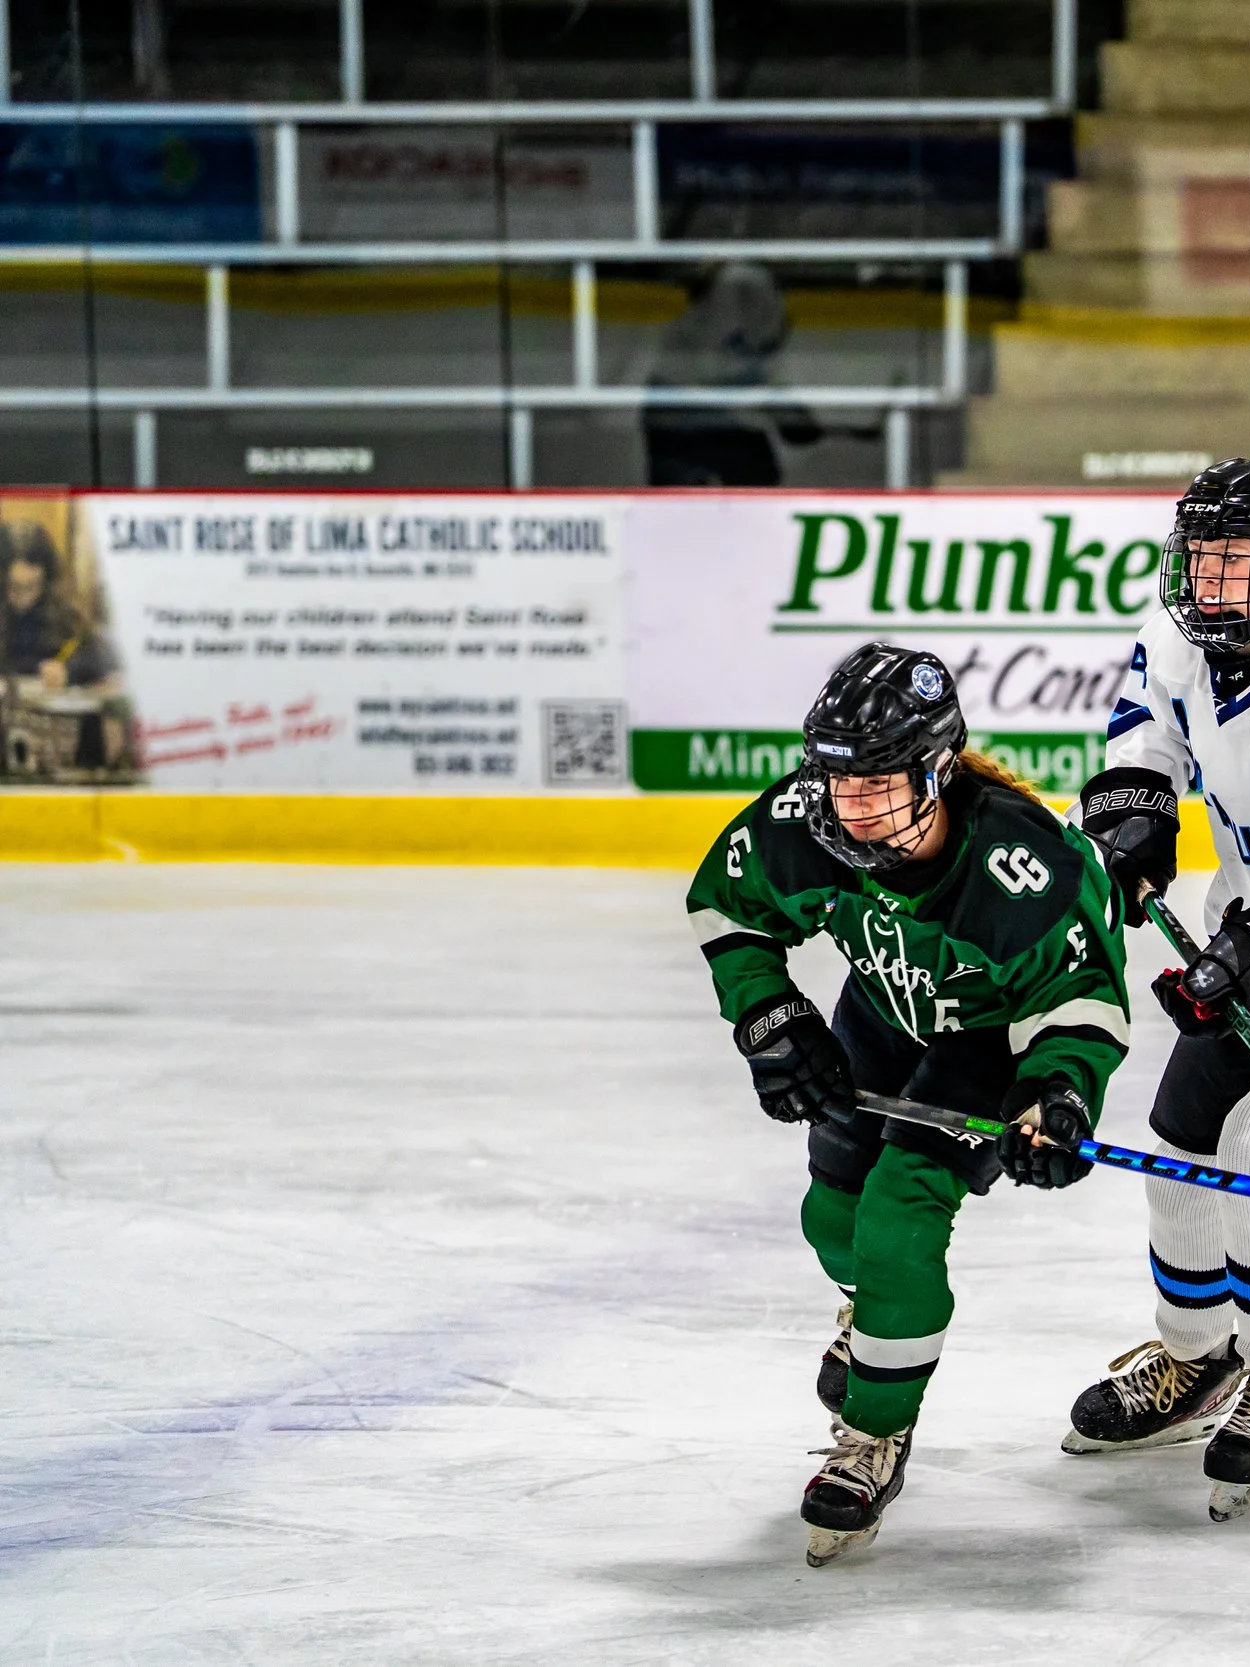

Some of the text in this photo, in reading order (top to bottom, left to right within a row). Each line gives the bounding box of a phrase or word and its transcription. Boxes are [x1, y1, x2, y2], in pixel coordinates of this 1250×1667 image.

[1184, 503, 1222, 513] CCM
[107, 515, 608, 553] SAINT ROSE OF LIMA CATHOLIC SCHOOL
[1095, 1144, 1236, 1188] CCM
